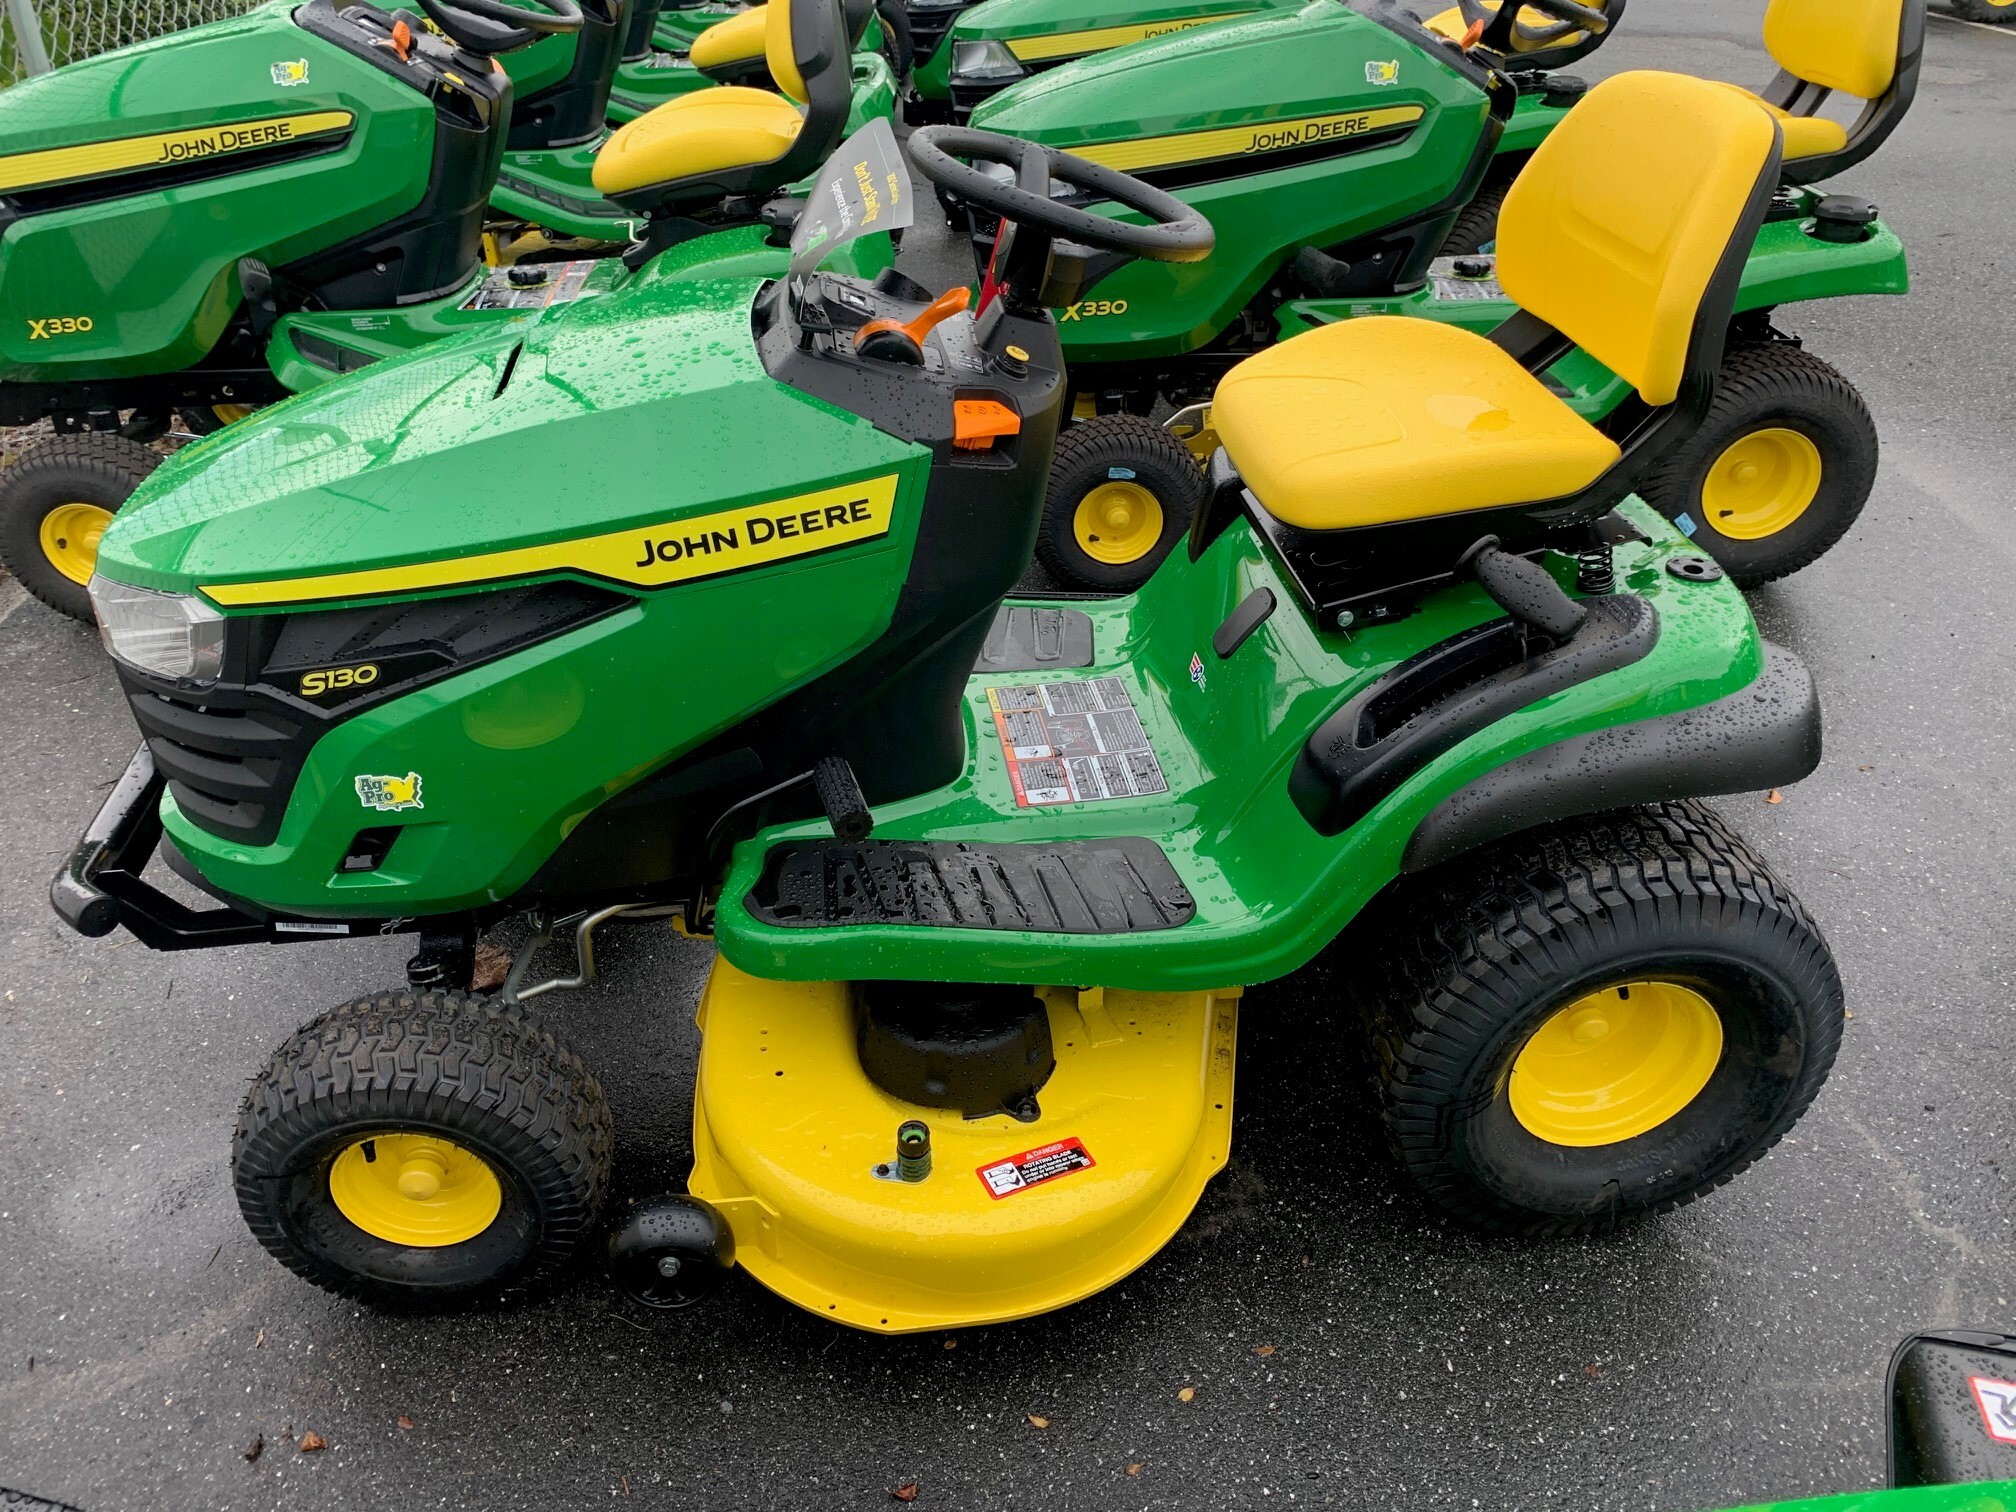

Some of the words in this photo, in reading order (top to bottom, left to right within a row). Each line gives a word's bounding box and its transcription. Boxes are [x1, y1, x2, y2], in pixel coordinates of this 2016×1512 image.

[159, 137, 216, 161] JOHN
[219, 123, 292, 149] DEERE
[1245, 129, 1300, 151] JOHN
[1305, 116, 1369, 140] DEERE
[1060, 300, 1128, 322] X330
[27, 316, 93, 340] X330
[636, 528, 740, 567] JOHN
[745, 498, 872, 546] DEERE
[301, 665, 378, 696] S130
[360, 778, 389, 793] Ag-
[363, 790, 394, 804] Pro
[1023, 1156, 1052, 1169] ROTATING
[1052, 1150, 1072, 1159] BLADE
[1033, 1143, 1064, 1157] DANGER
